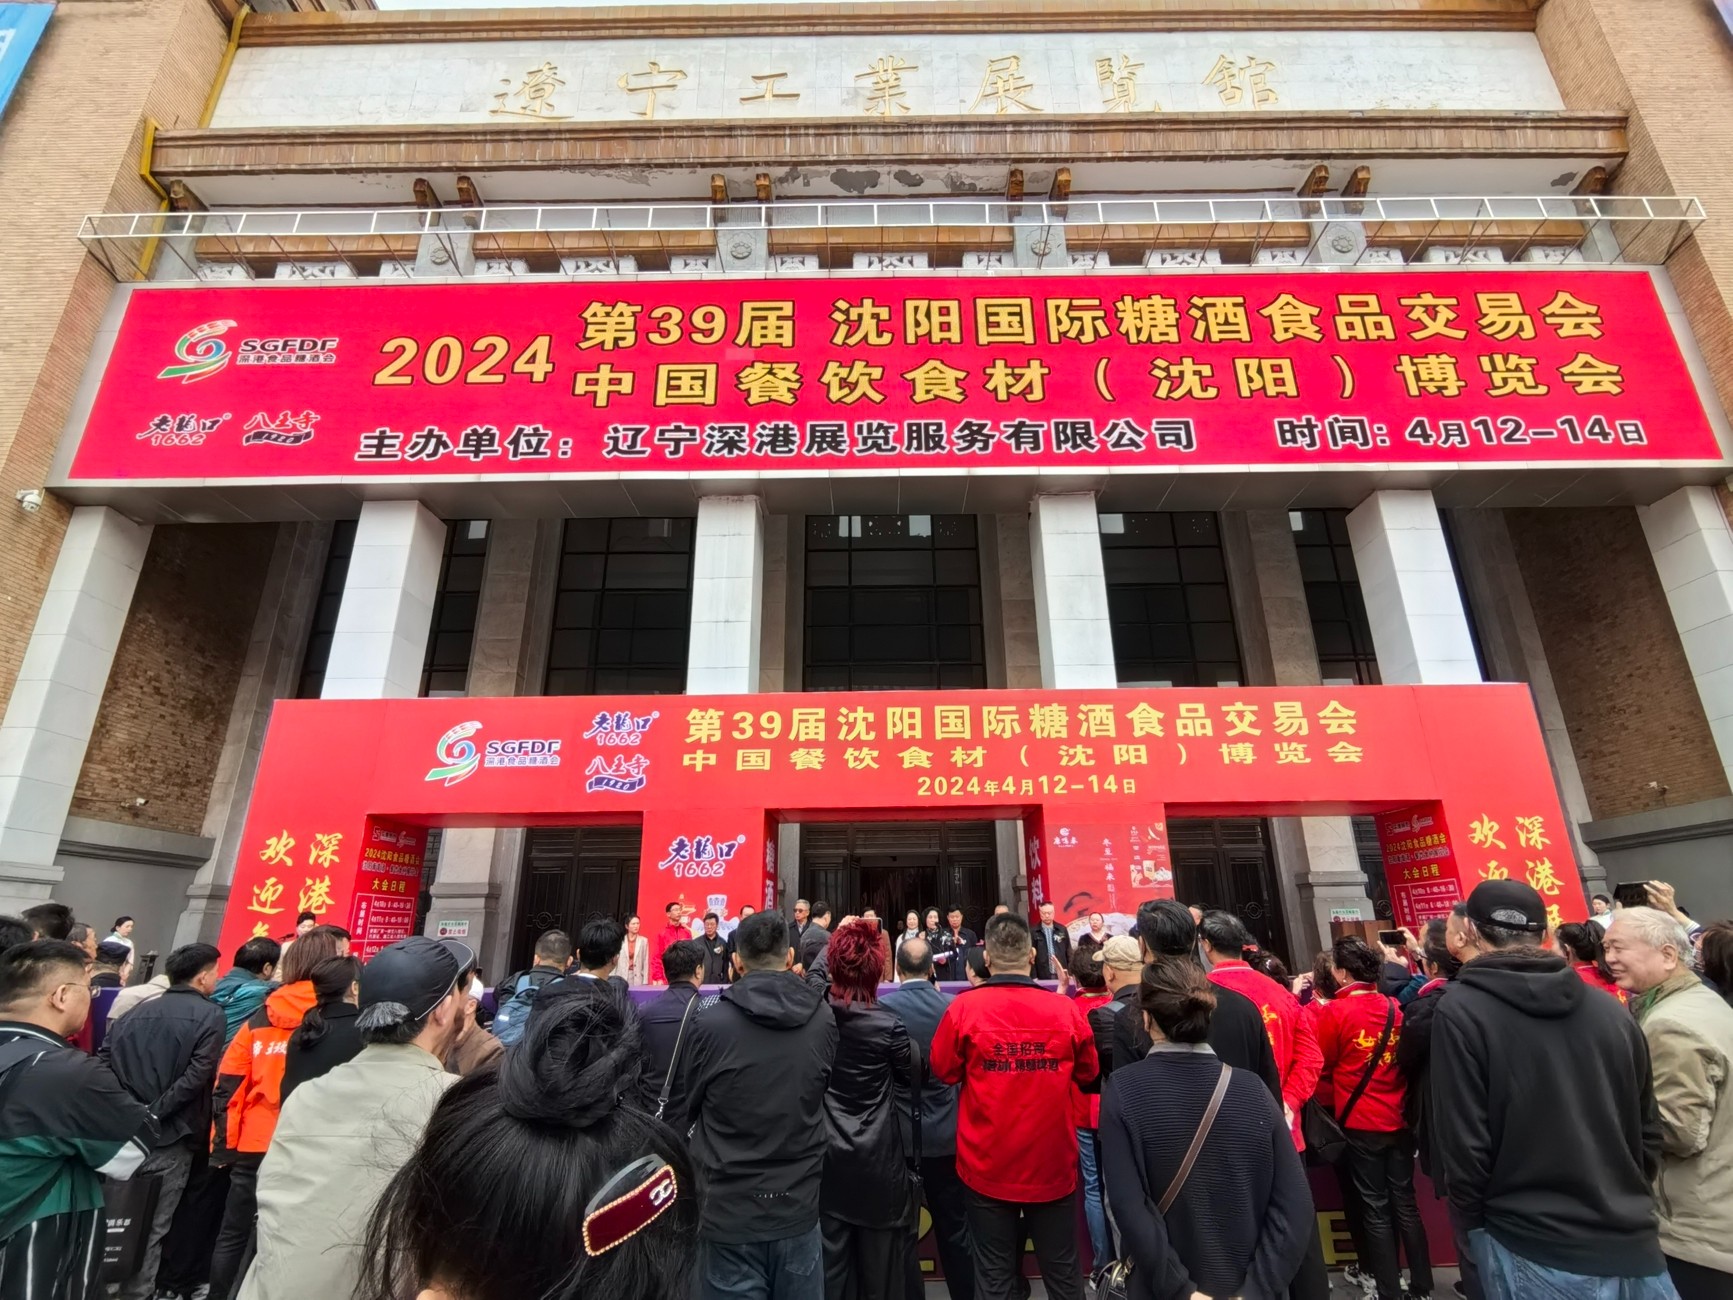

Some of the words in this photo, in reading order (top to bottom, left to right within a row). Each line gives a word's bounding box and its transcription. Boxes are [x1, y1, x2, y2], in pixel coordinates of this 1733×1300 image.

[577, 300, 796, 351] 第39届
[831, 291, 1605, 346] 沈阳国际糖酒食品交易会
[238, 338, 338, 353] SGFDF
[372, 334, 555, 386] 2024
[151, 433, 206, 446] 1662
[684, 700, 1357, 744] 第39届沈阳国际糖酒食品交易会
[596, 732, 643, 746] 1662
[485, 740, 561, 754] SGFDF
[917, 774, 1136, 797] 2024年4月12-14日
[674, 861, 725, 877] 1662
[1403, 864, 1440, 879] 大会日程
[371, 878, 406, 893] 大会日程
[993, 1041, 1046, 1056] 全国招商
